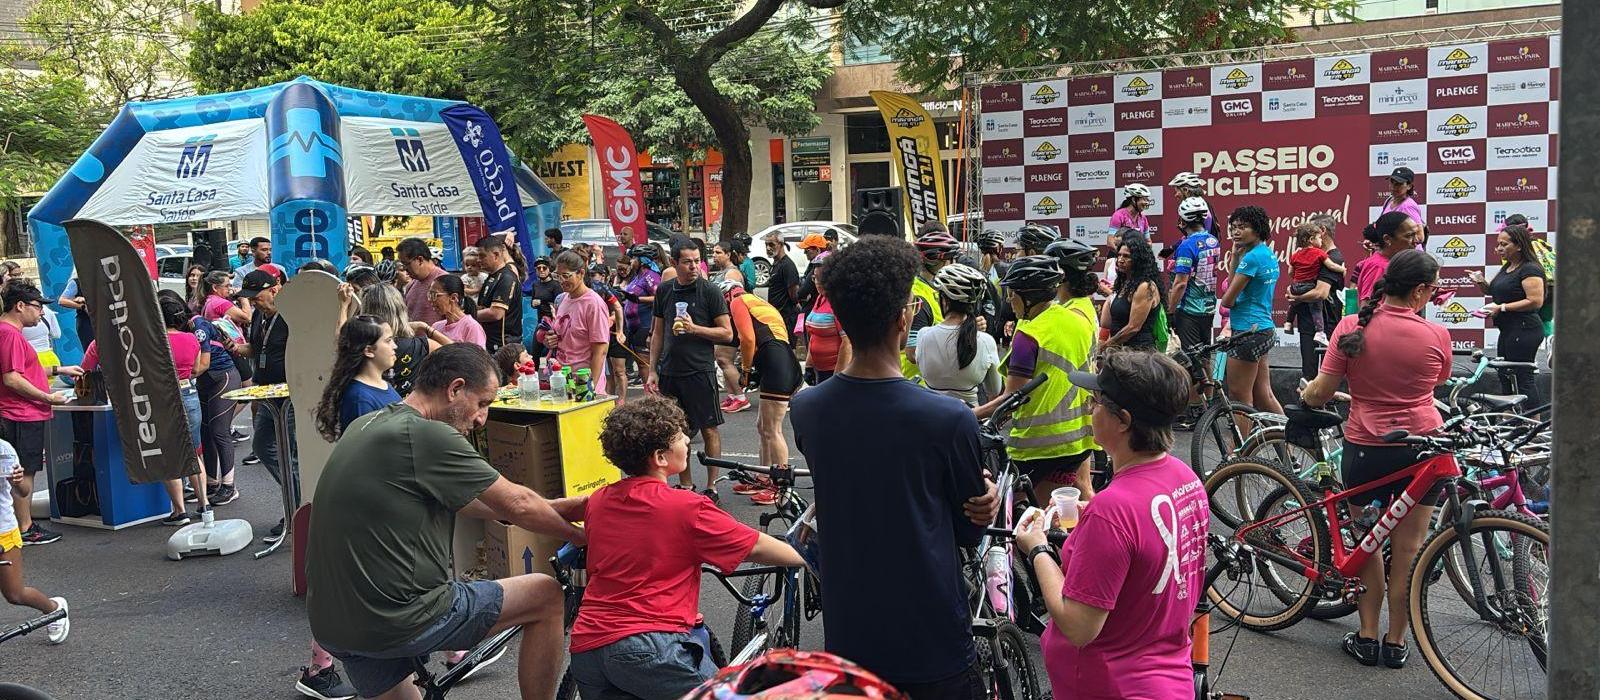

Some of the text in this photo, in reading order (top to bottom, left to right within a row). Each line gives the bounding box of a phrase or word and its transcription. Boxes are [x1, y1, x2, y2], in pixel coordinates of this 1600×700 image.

[1436, 86, 1478, 97] PLAENGE
[1224, 101, 1250, 111] GMC
[1121, 111, 1155, 120] PLAENGE
[1193, 144, 1335, 174] PASSEIO
[1442, 148, 1471, 159] GMC
[480, 149, 517, 222] preço
[607, 145, 639, 223] GMC
[1031, 173, 1062, 182] PLAENGE
[146, 187, 216, 206] Santa Casa
[391, 182, 460, 198] Santa Casa
[923, 190, 938, 220] FM
[1435, 215, 1477, 225] PLAENGE
[1361, 490, 1416, 553] CALOI
